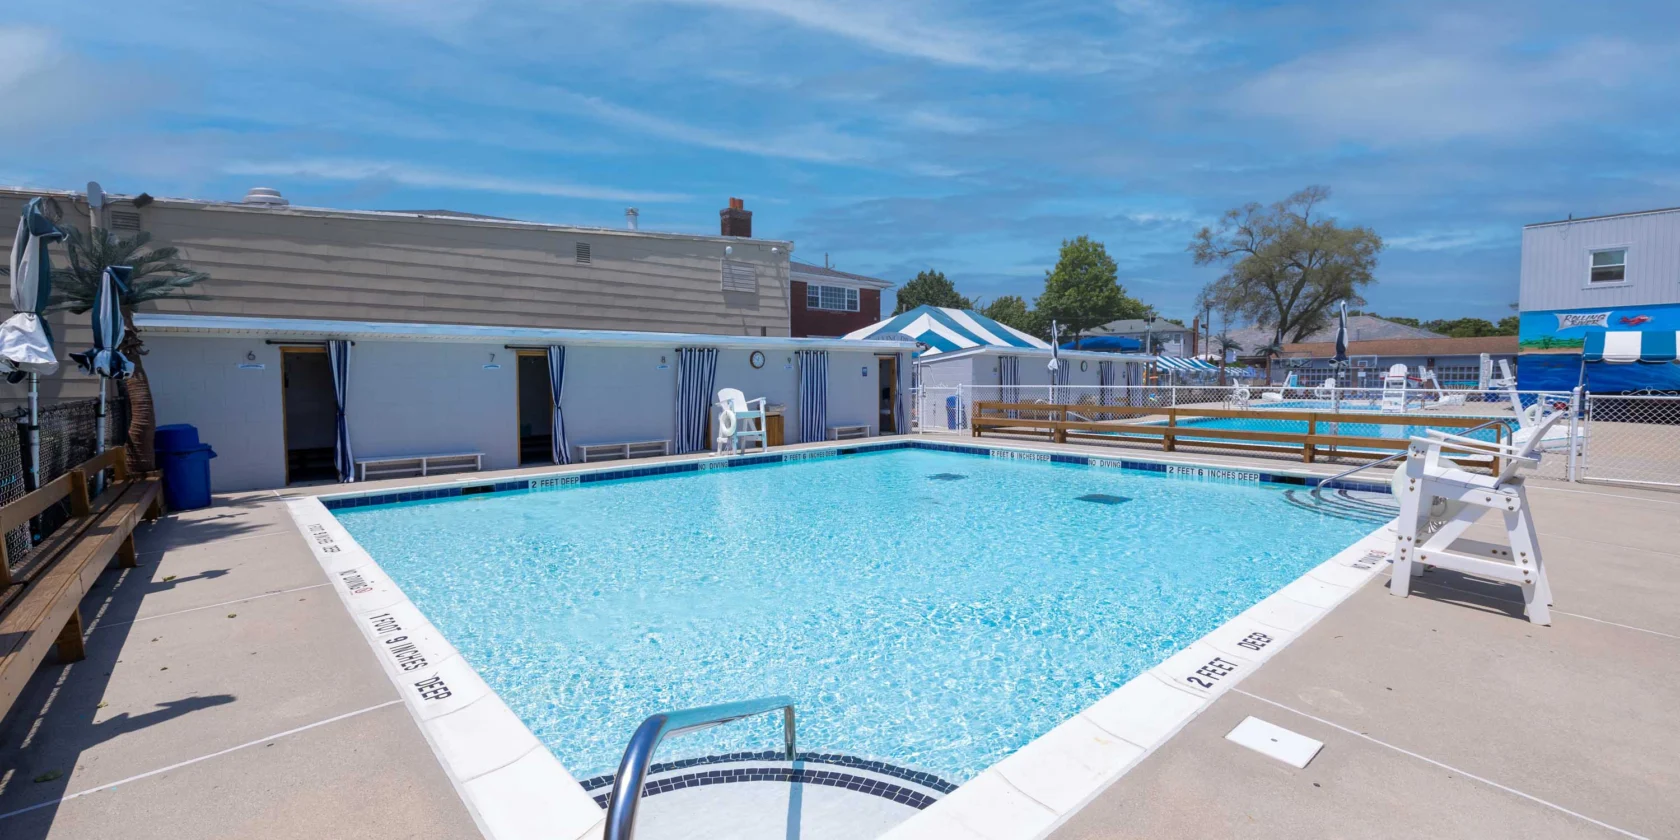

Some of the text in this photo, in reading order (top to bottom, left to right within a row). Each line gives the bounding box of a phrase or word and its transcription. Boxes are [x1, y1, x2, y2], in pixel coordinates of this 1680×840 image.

[1564, 314, 1606, 323] ROLLING
[247, 350, 256, 361] 6
[489, 353, 495, 362] 7
[661, 356, 666, 364] 8
[789, 453, 801, 461] FEET
[808, 451, 825, 459] INCHES
[825, 450, 837, 458] DEEP
[996, 450, 1009, 458] FEET
[1016, 452, 1036, 460] INCHES
[1036, 453, 1051, 461] DEEP
[699, 461, 728, 471] NO DIVING
[1100, 460, 1121, 468] DIVING
[1169, 466, 1259, 481] 2 FEET 6 INCHES DEEP
[540, 479, 559, 487] FEET
[560, 476, 579, 486] DEEP
[371, 617, 402, 635] FOOT
[385, 635, 408, 645] 9
[389, 642, 428, 671] INCHES
[1186, 631, 1274, 688] 2 FEET DEEP
[414, 676, 452, 701] DEEP
